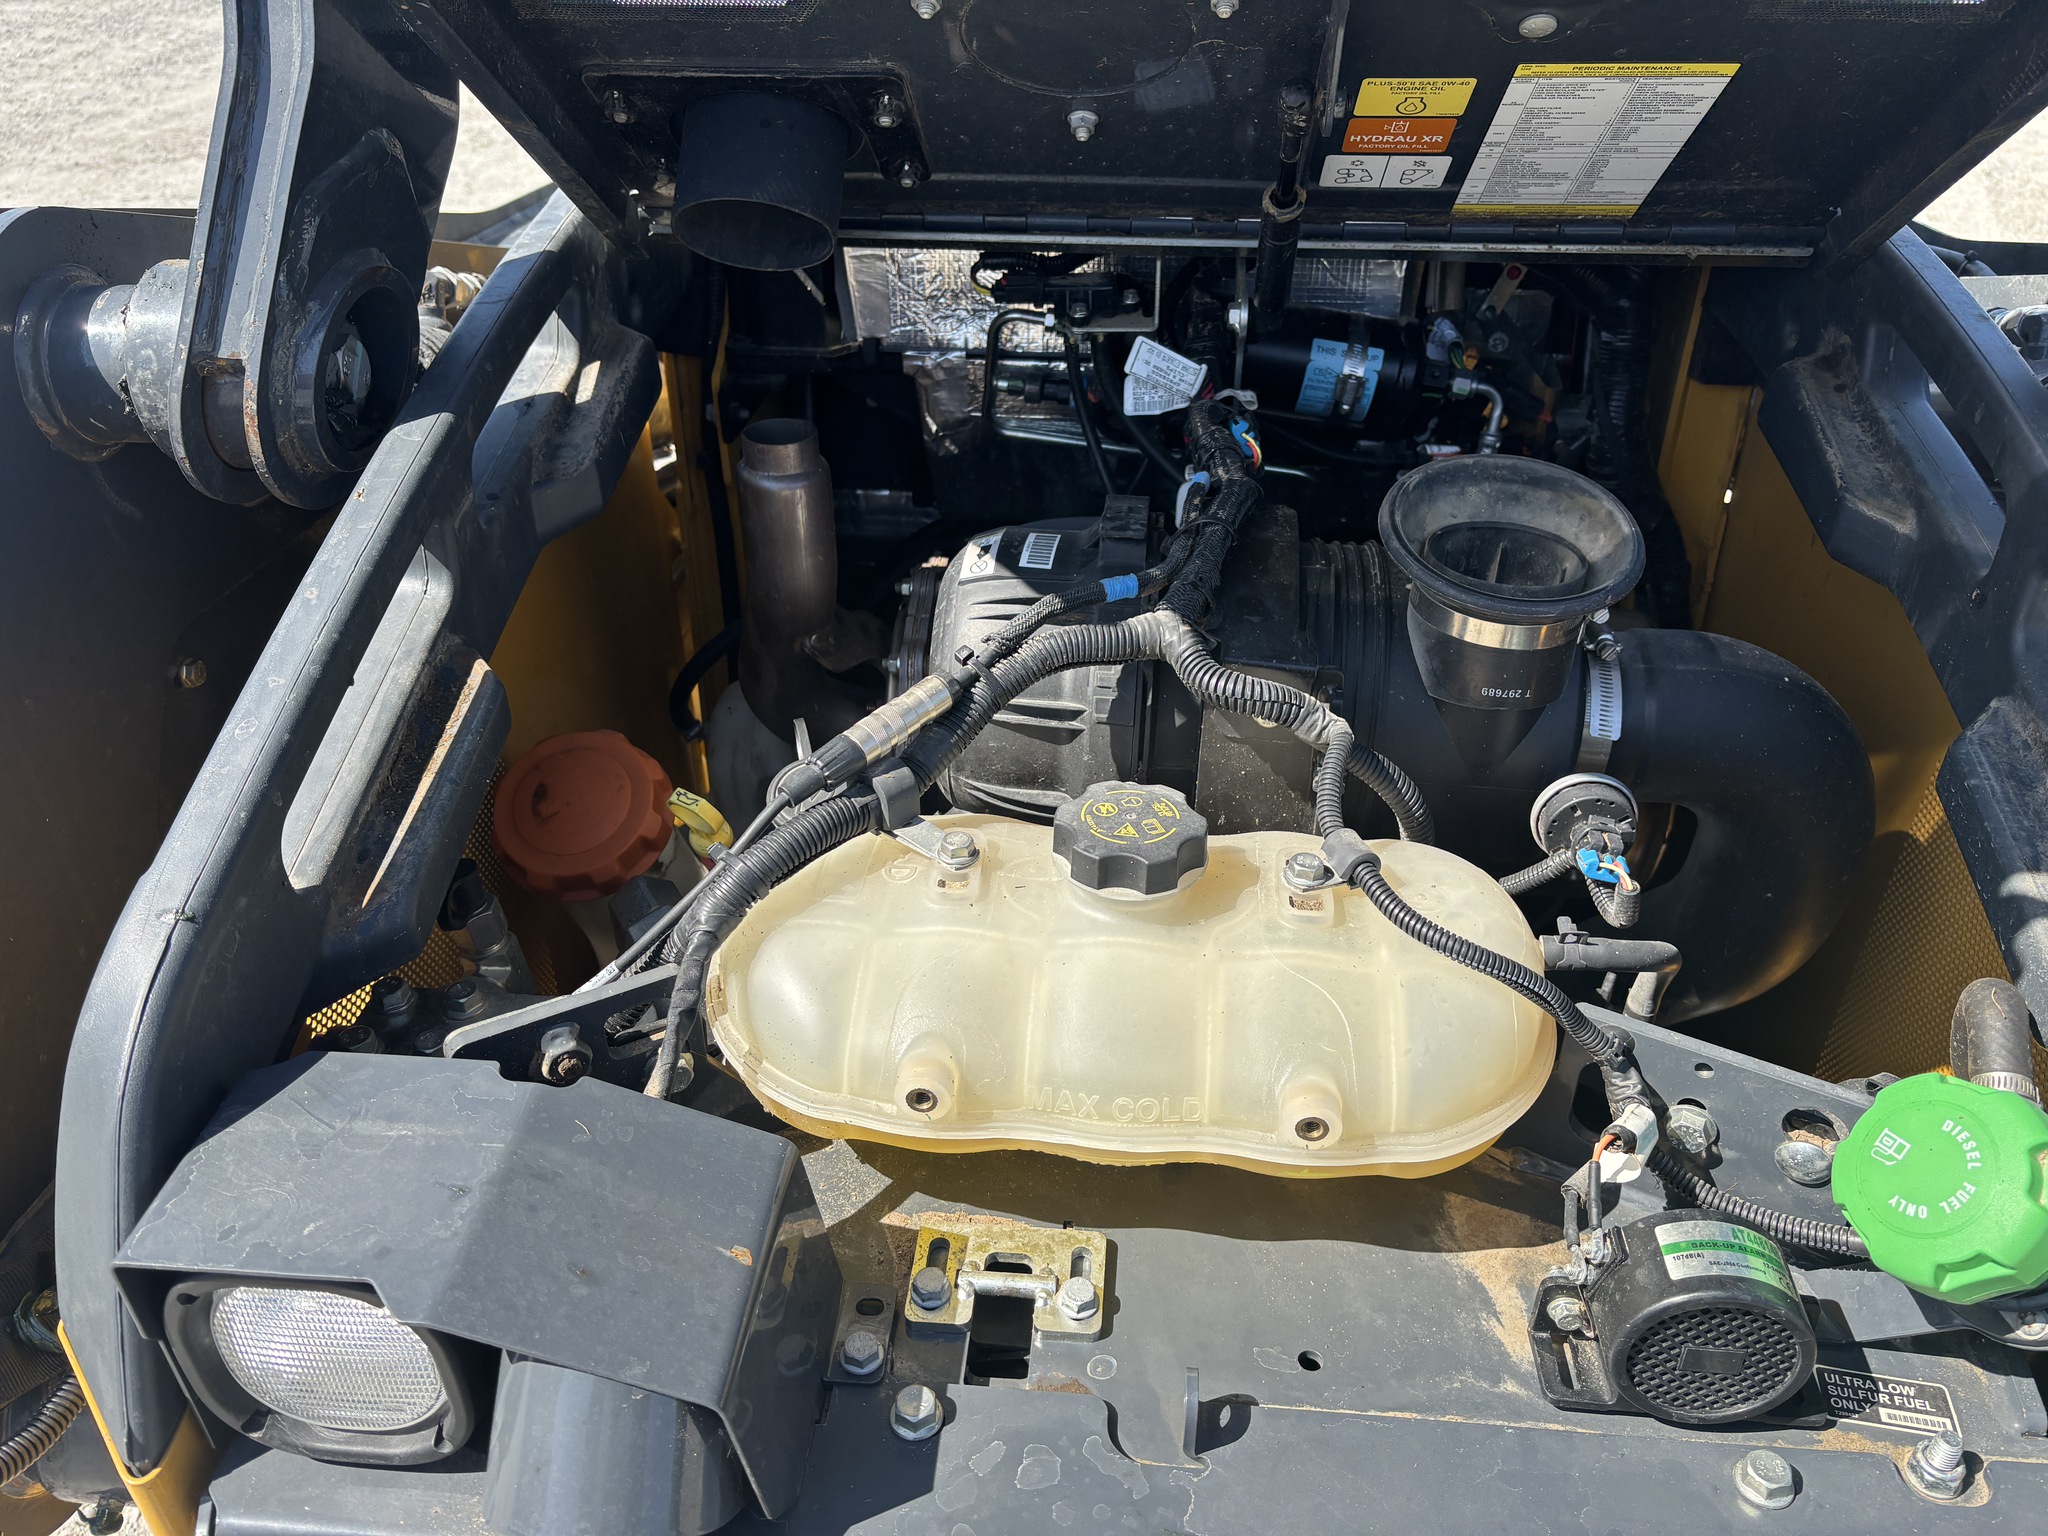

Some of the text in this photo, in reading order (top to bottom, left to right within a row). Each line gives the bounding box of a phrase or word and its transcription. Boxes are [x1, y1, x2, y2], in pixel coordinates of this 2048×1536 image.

[1316, 346, 1336, 356] THIS
[1481, 687, 1531, 698] T 297689
[1026, 1086, 1206, 1123] MAX COLD
[1887, 1120, 1982, 1219] DIESEL FUEL ONLY
[1672, 1252, 1704, 1261] 107dB(A)
[1738, 1245, 1768, 1260] ALARM
[1824, 1372, 1916, 1397] ULTRA LOW
[1828, 1385, 1937, 1412] SULFUR FUEL
[1830, 1398, 1872, 1413] ONLY
